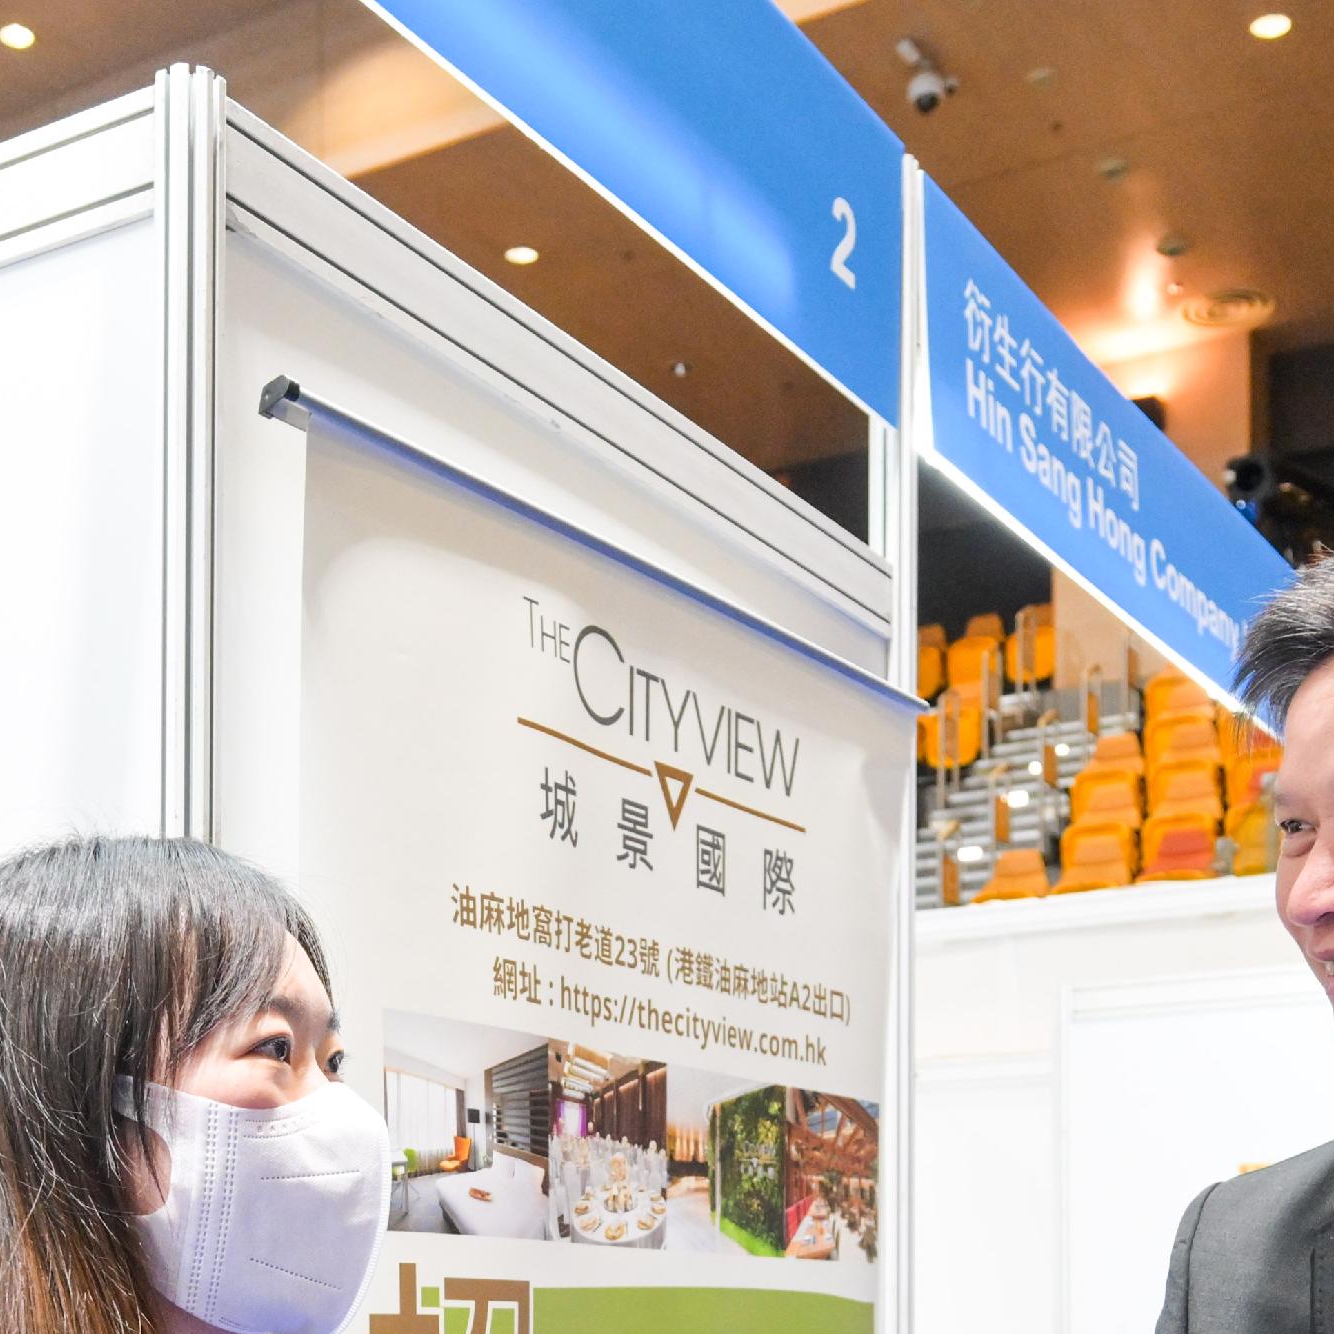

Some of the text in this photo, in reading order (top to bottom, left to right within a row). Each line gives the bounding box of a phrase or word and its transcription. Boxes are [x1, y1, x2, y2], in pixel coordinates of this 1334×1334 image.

[830, 196, 857, 290] 2
[964, 279, 1139, 510] 衍生行有限公司
[966, 359, 1014, 454] Hin
[1019, 412, 1083, 530] Sang
[1088, 474, 1147, 586] Hong
[523, 596, 571, 664] THE
[540, 766, 796, 915] 城景國際
[451, 883, 851, 1026] 油麻地窩打老道23號 (港鐵油麻地站A2出口)
